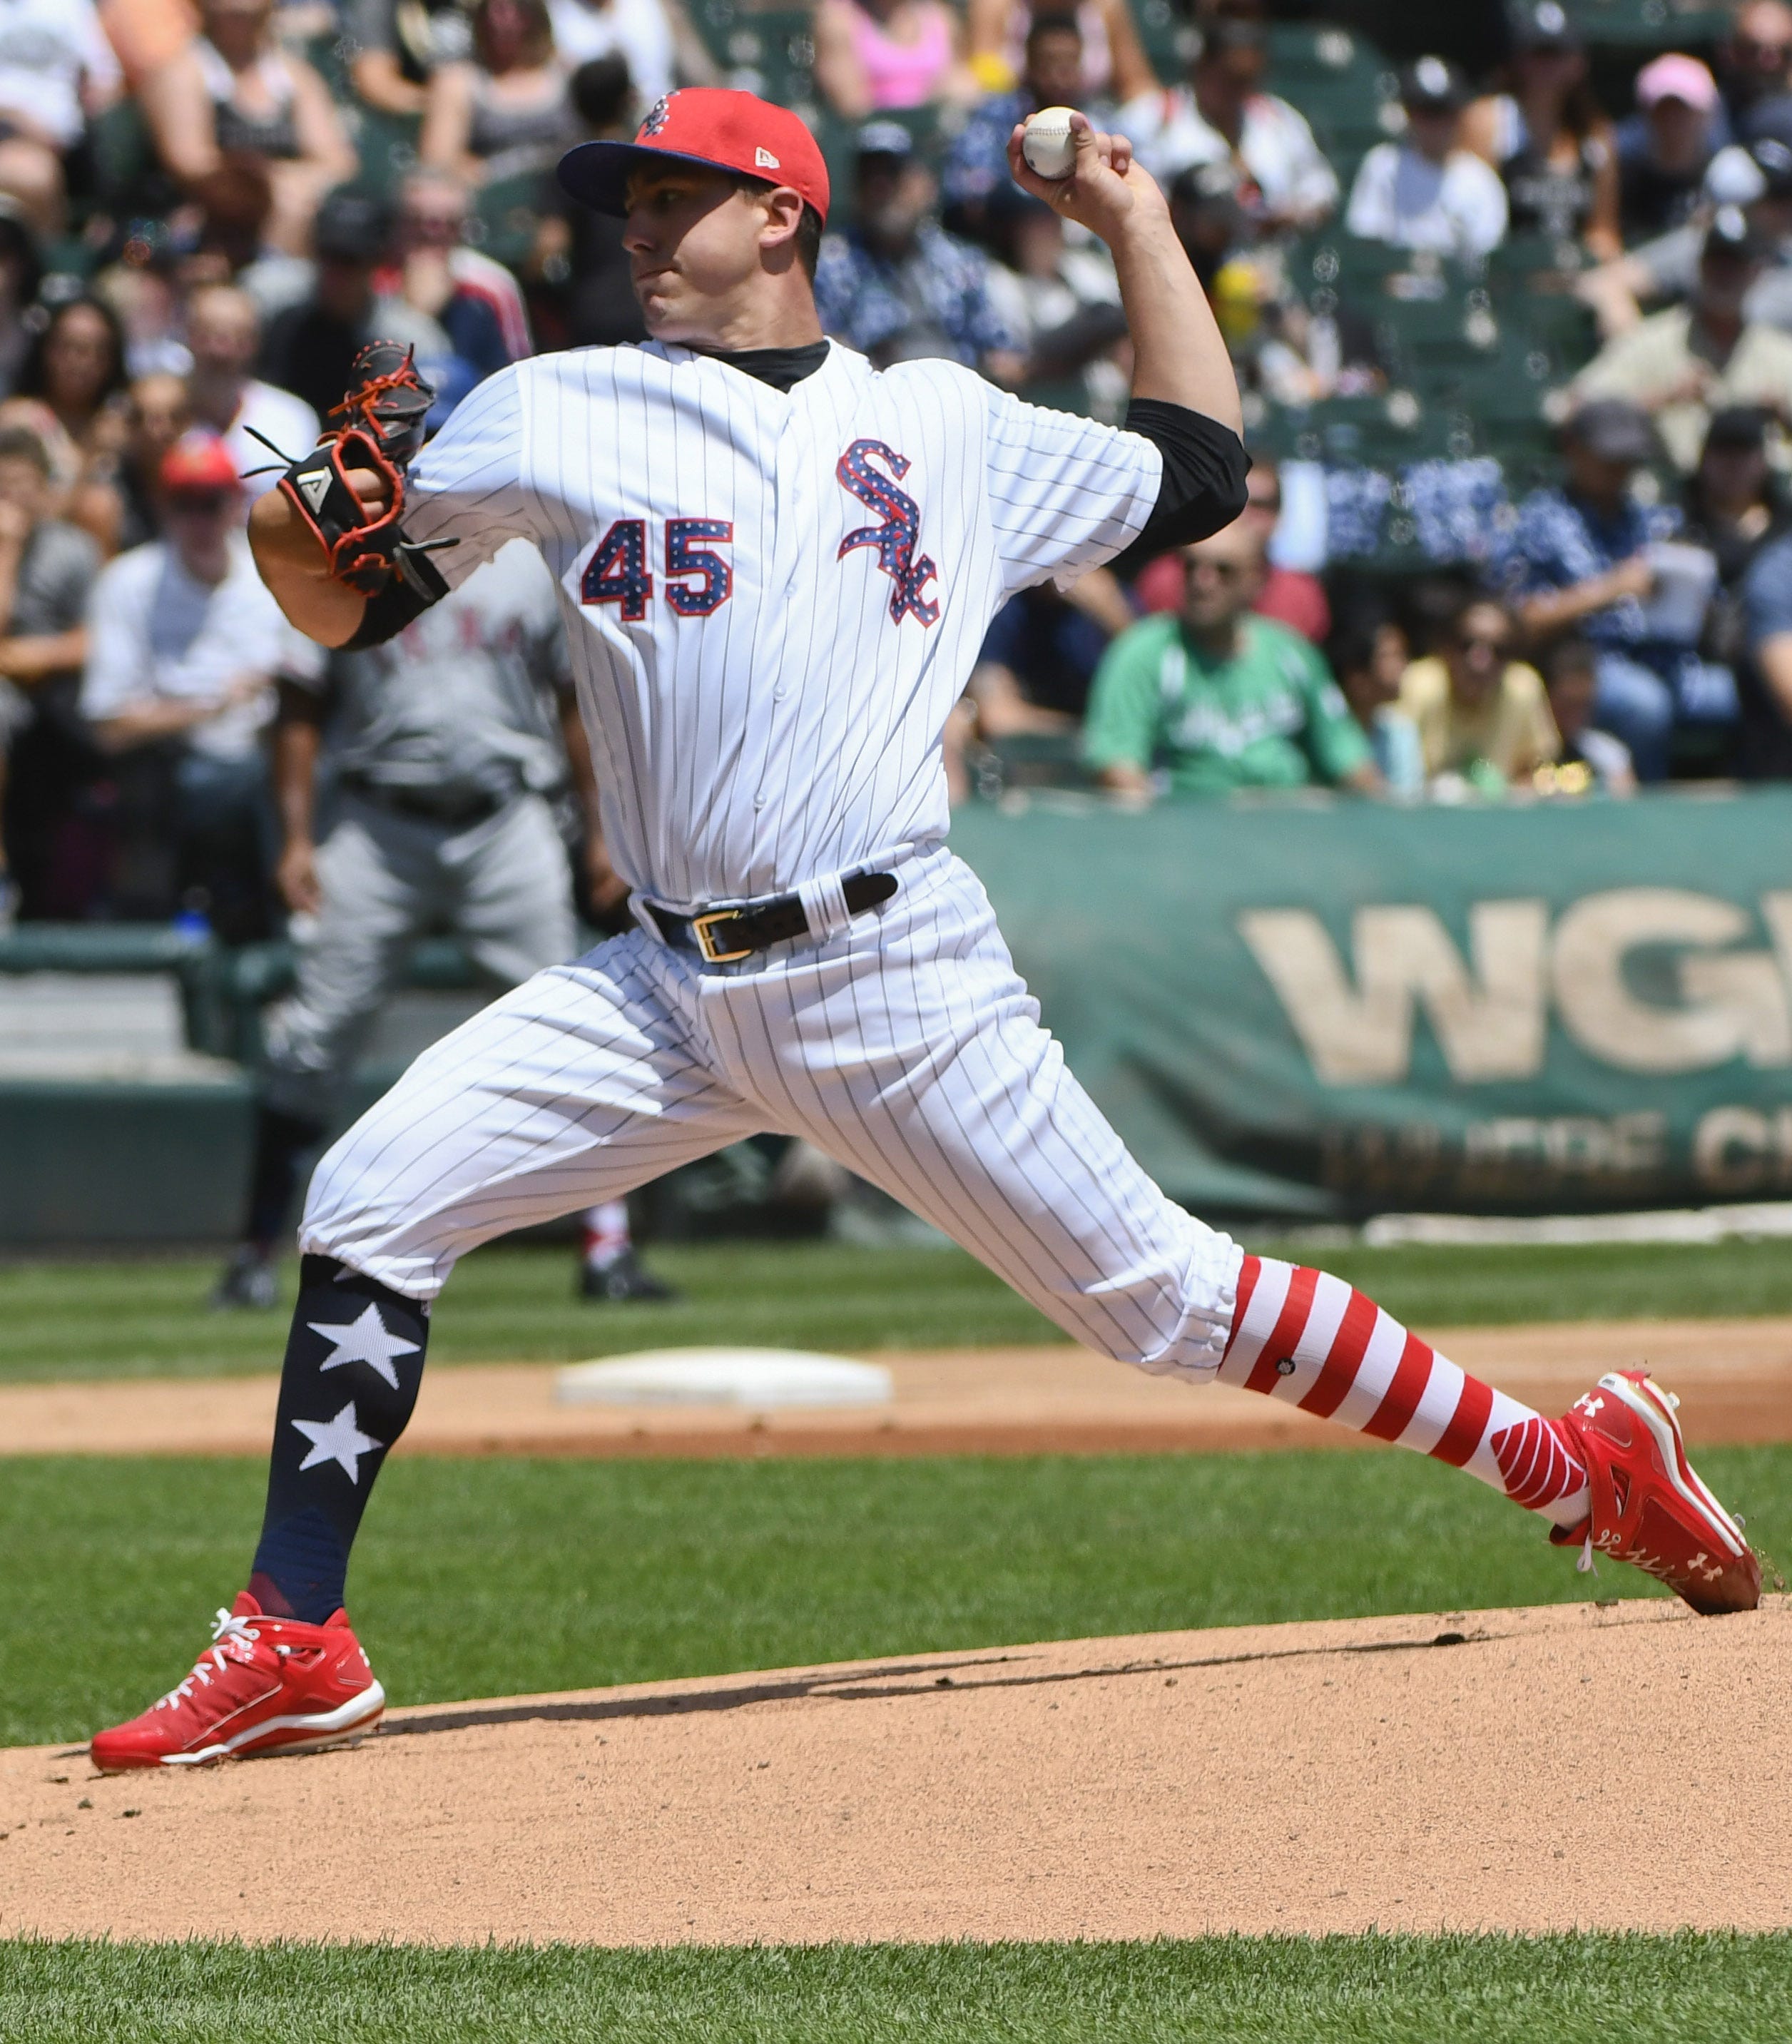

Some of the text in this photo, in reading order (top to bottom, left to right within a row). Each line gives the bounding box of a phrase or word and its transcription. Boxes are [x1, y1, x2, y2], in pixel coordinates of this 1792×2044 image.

[581, 517, 734, 621] 45
[836, 438, 940, 629] Sox
[1237, 885, 1792, 1087] WG
[1694, 1103, 1792, 1196] C
